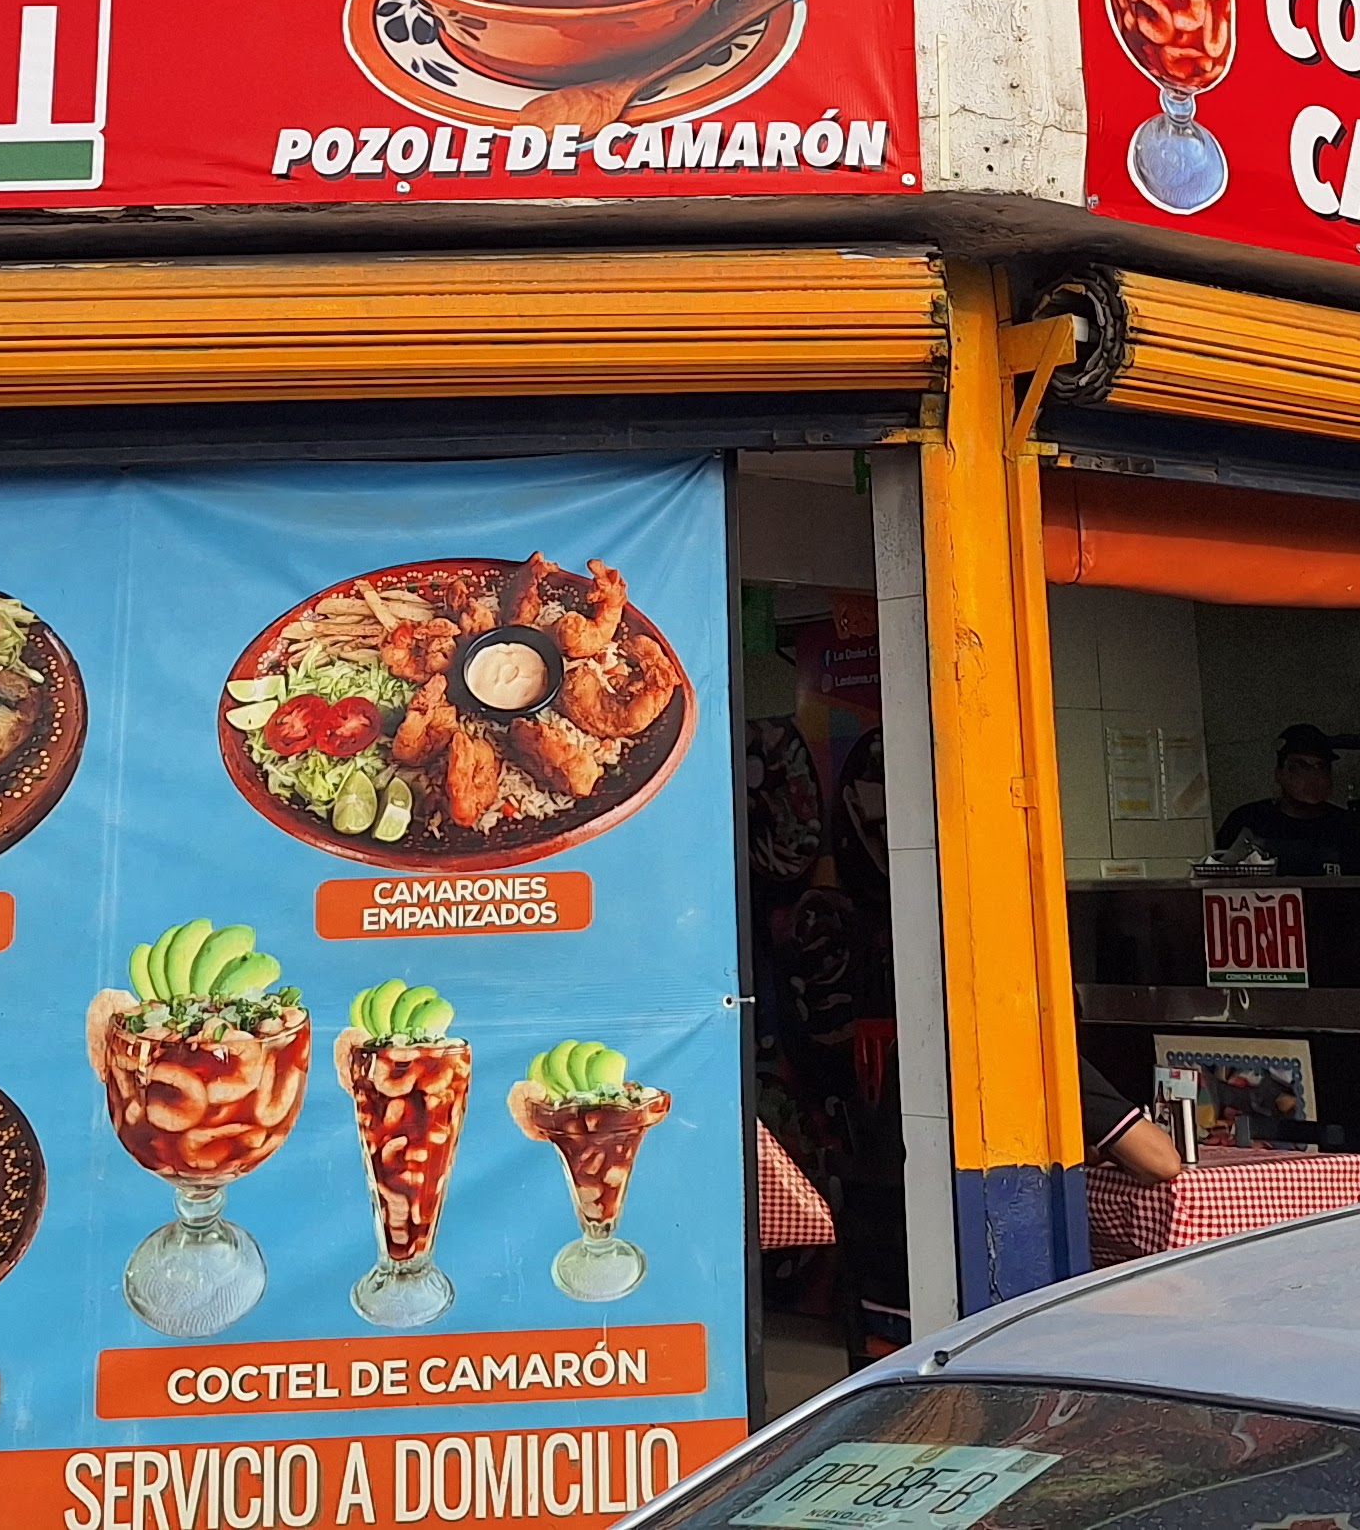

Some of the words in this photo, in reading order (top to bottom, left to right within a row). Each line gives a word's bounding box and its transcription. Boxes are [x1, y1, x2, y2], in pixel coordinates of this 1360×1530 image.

[271, 125, 496, 176] POZOLE
[506, 123, 583, 172] DE
[594, 108, 888, 170] CAMARÓN
[362, 901, 558, 931] EMPANIZADOS
[373, 876, 549, 905] CAMARONES
[1228, 896, 1250, 911] LA
[1205, 891, 1305, 968] DOÑA
[167, 1363, 340, 1405] COCTEL
[351, 1359, 409, 1397] DE
[418, 1342, 648, 1394] CAMARÓN
[64, 1444, 317, 1530] SERVICIO
[336, 1441, 376, 1524] A
[394, 1427, 680, 1523] DOMICILIO
[775, 1462, 999, 1515] RPP-685-B
